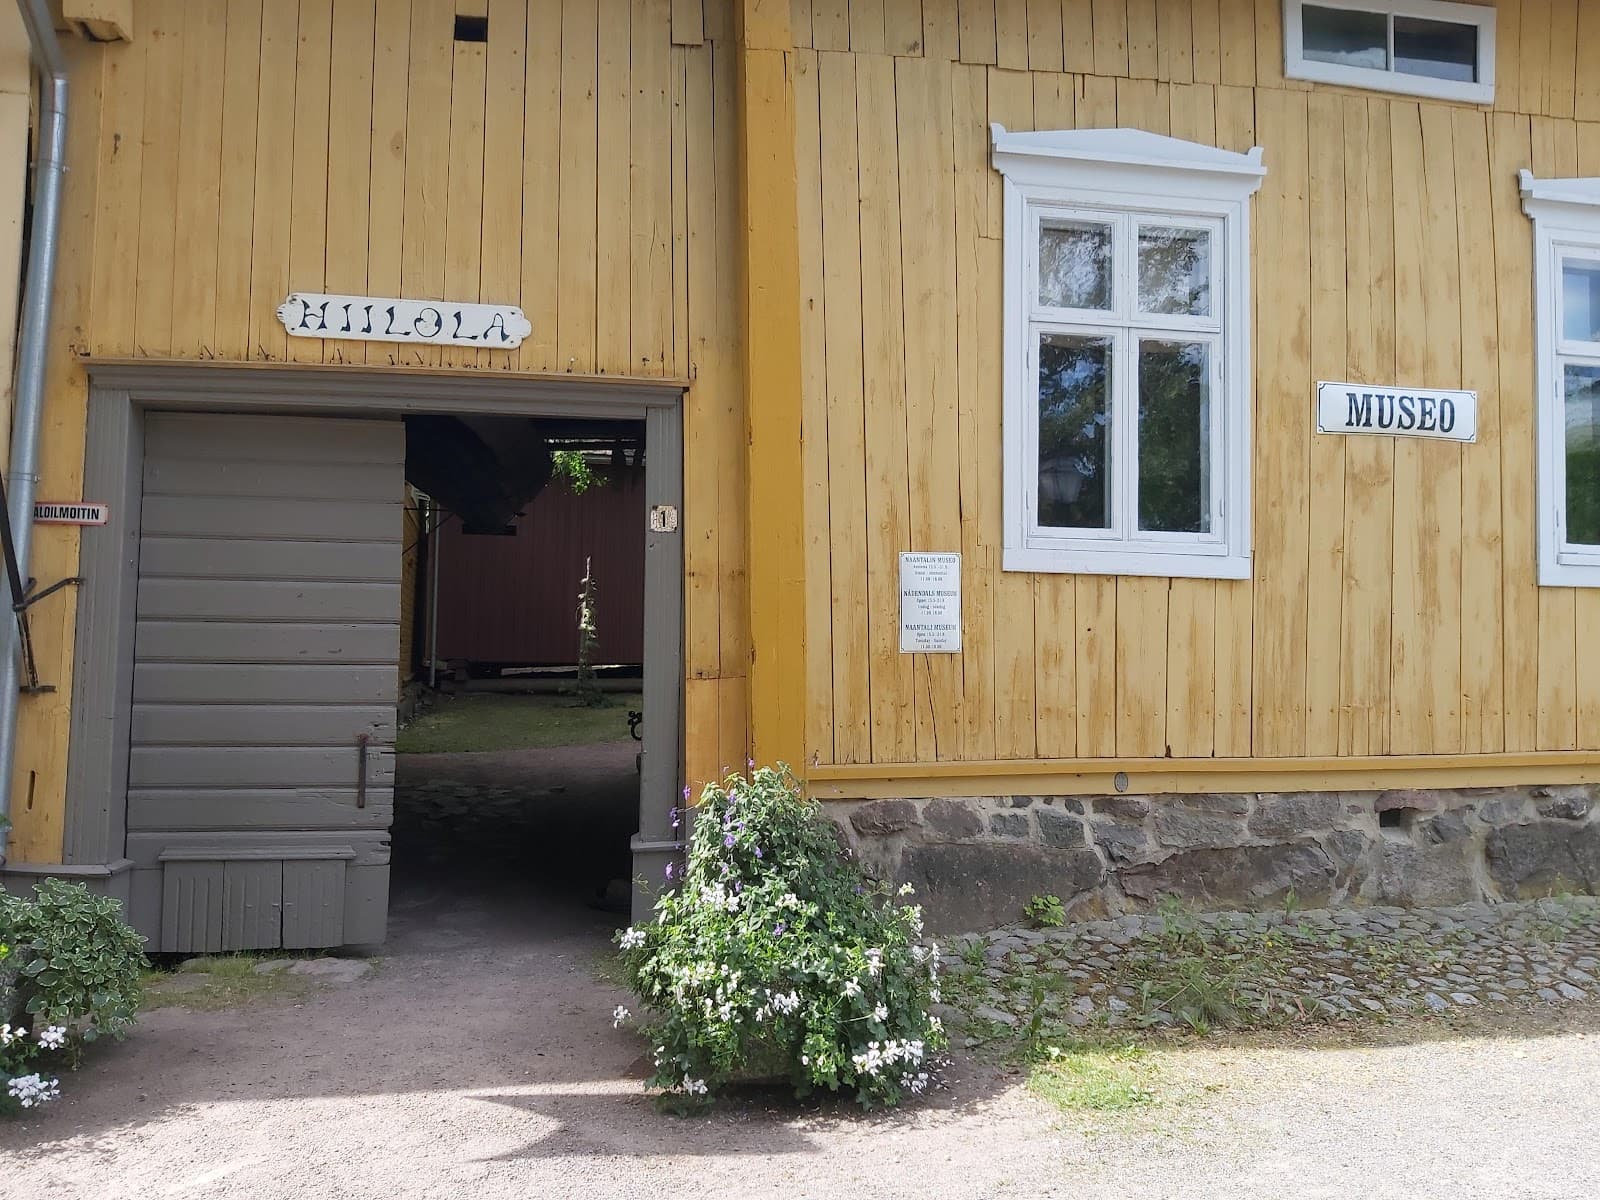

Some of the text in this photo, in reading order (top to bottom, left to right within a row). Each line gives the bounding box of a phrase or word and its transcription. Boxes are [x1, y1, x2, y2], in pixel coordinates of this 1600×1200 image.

[299, 299, 510, 342] HIILOLA
[1345, 392, 1455, 433] MUSEO
[33, 505, 100, 520] ALOILMOITIN
